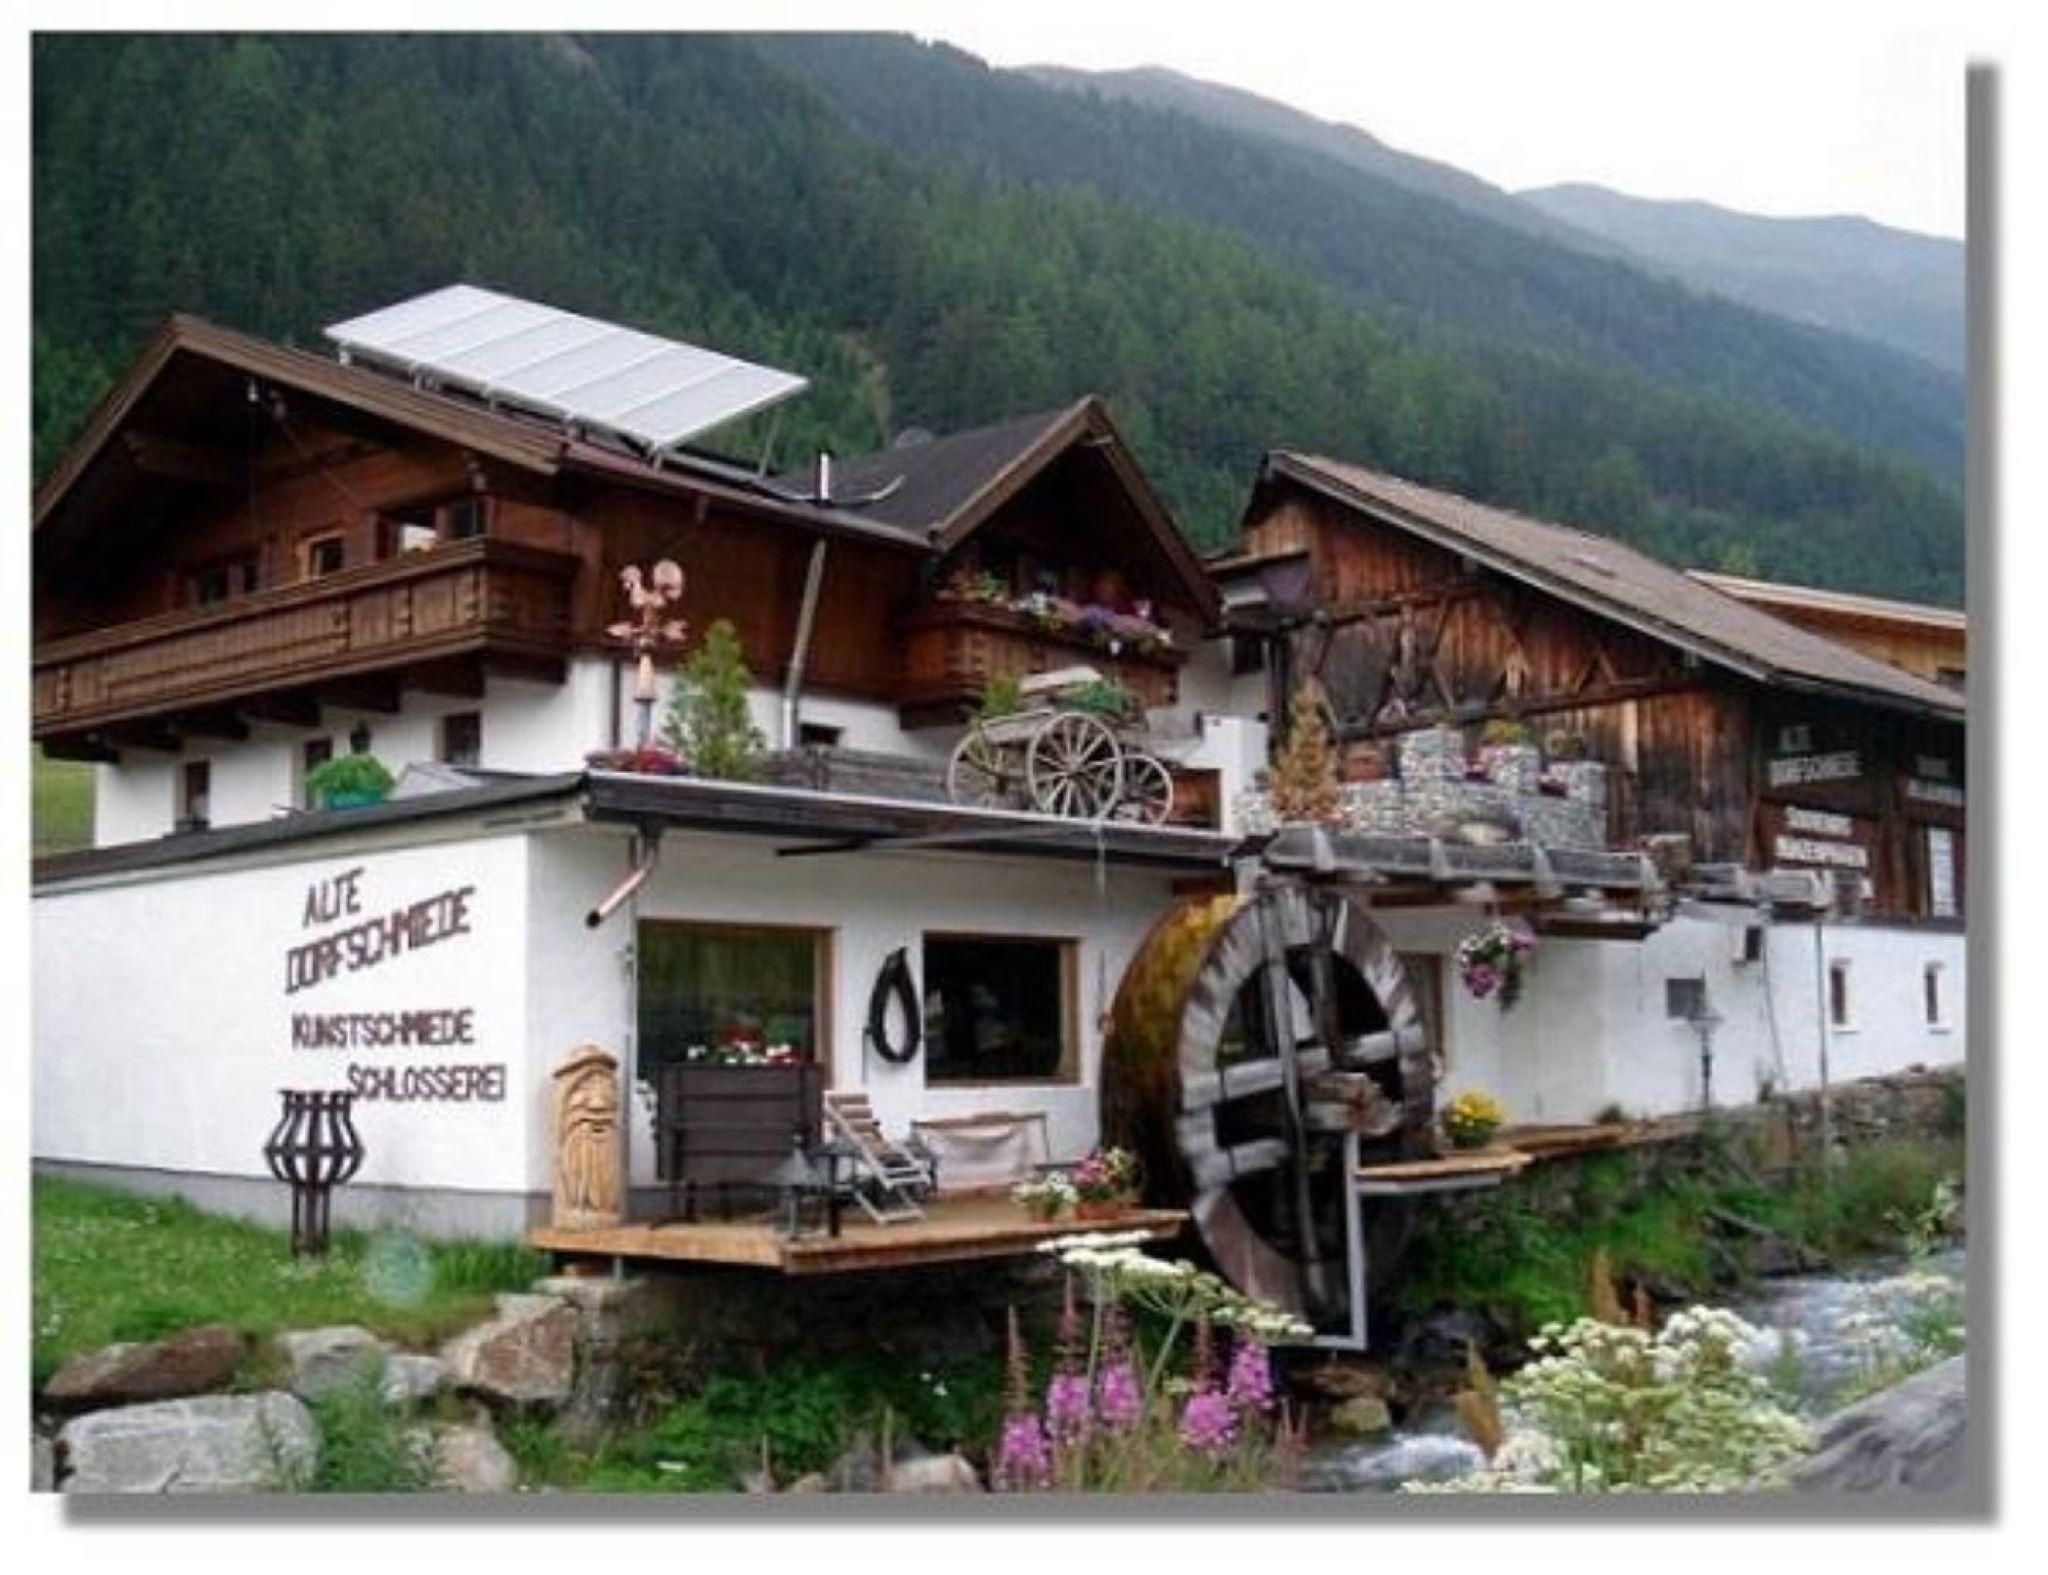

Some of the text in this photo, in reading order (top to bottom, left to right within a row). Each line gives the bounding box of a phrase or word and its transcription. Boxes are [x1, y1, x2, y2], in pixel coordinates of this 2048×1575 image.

[302, 866, 365, 929] ALTE
[284, 884, 477, 996] DORFSCHMIEDE
[290, 1008, 475, 1049] KUNSTSCHMIEDE
[347, 1061, 508, 1102] SCHLOSSEREI
